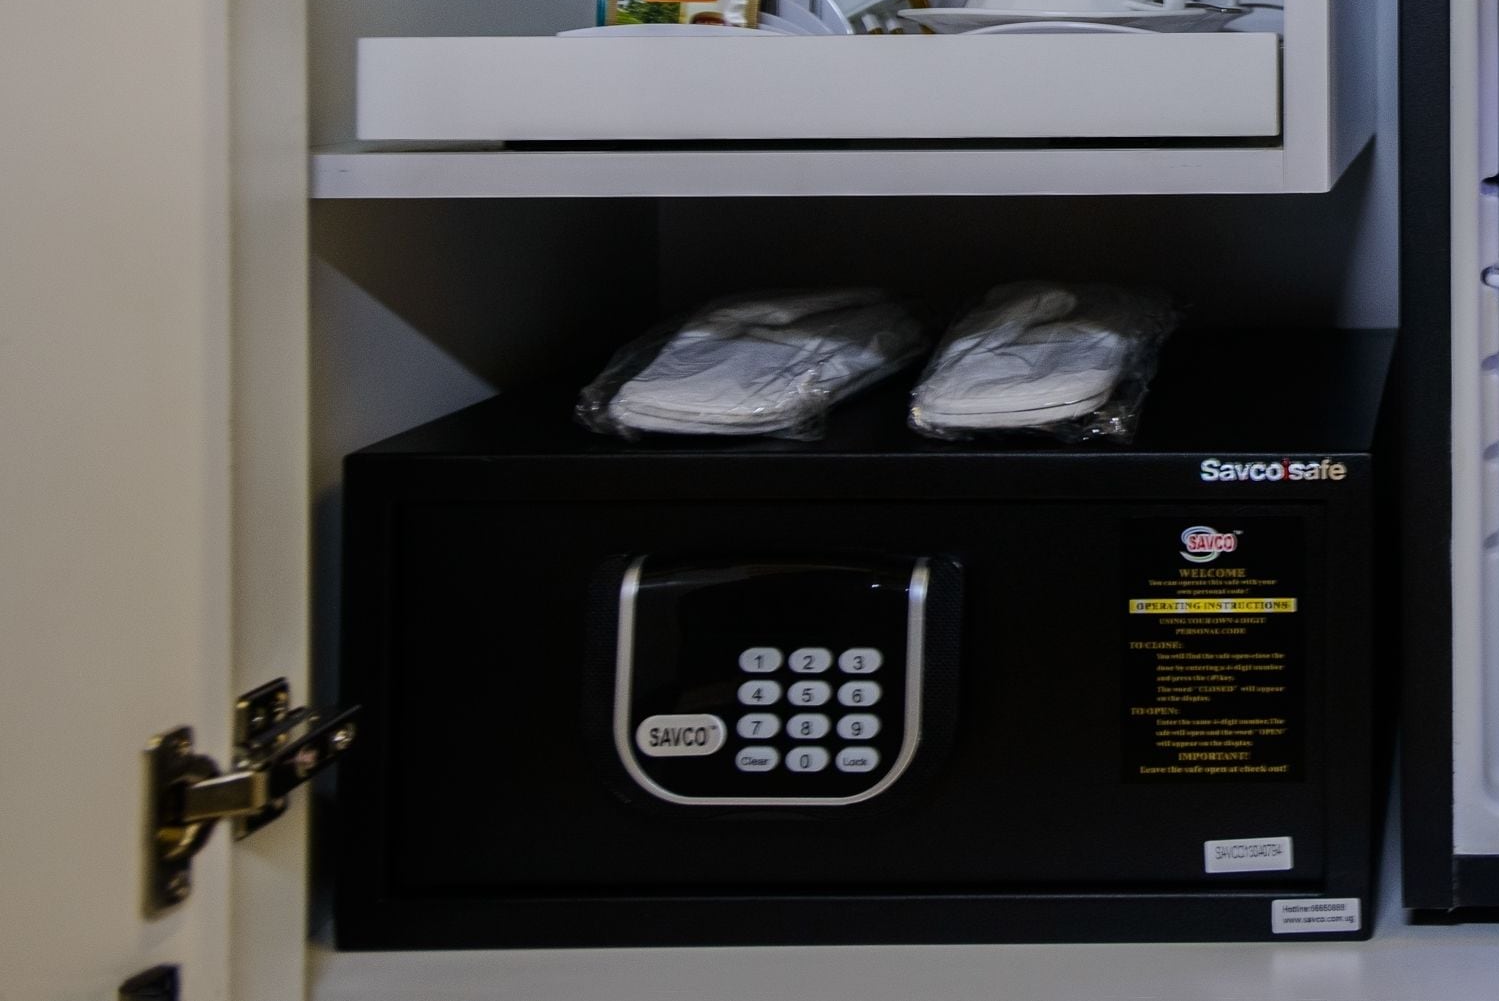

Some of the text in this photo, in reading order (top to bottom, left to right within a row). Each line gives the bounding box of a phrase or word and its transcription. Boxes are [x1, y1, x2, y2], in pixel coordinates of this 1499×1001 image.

[1188, 534, 1234, 551] SAVCO
[1178, 568, 1247, 578] WELCOME
[1136, 601, 1288, 611] OPERATING INSTRUCTIONS
[754, 654, 864, 670] 1 2 3
[751, 687, 862, 702] 4 5 6
[751, 721, 862, 735] 7 8 9
[649, 727, 708, 747] SAVCO
[799, 754, 810, 769] 0
